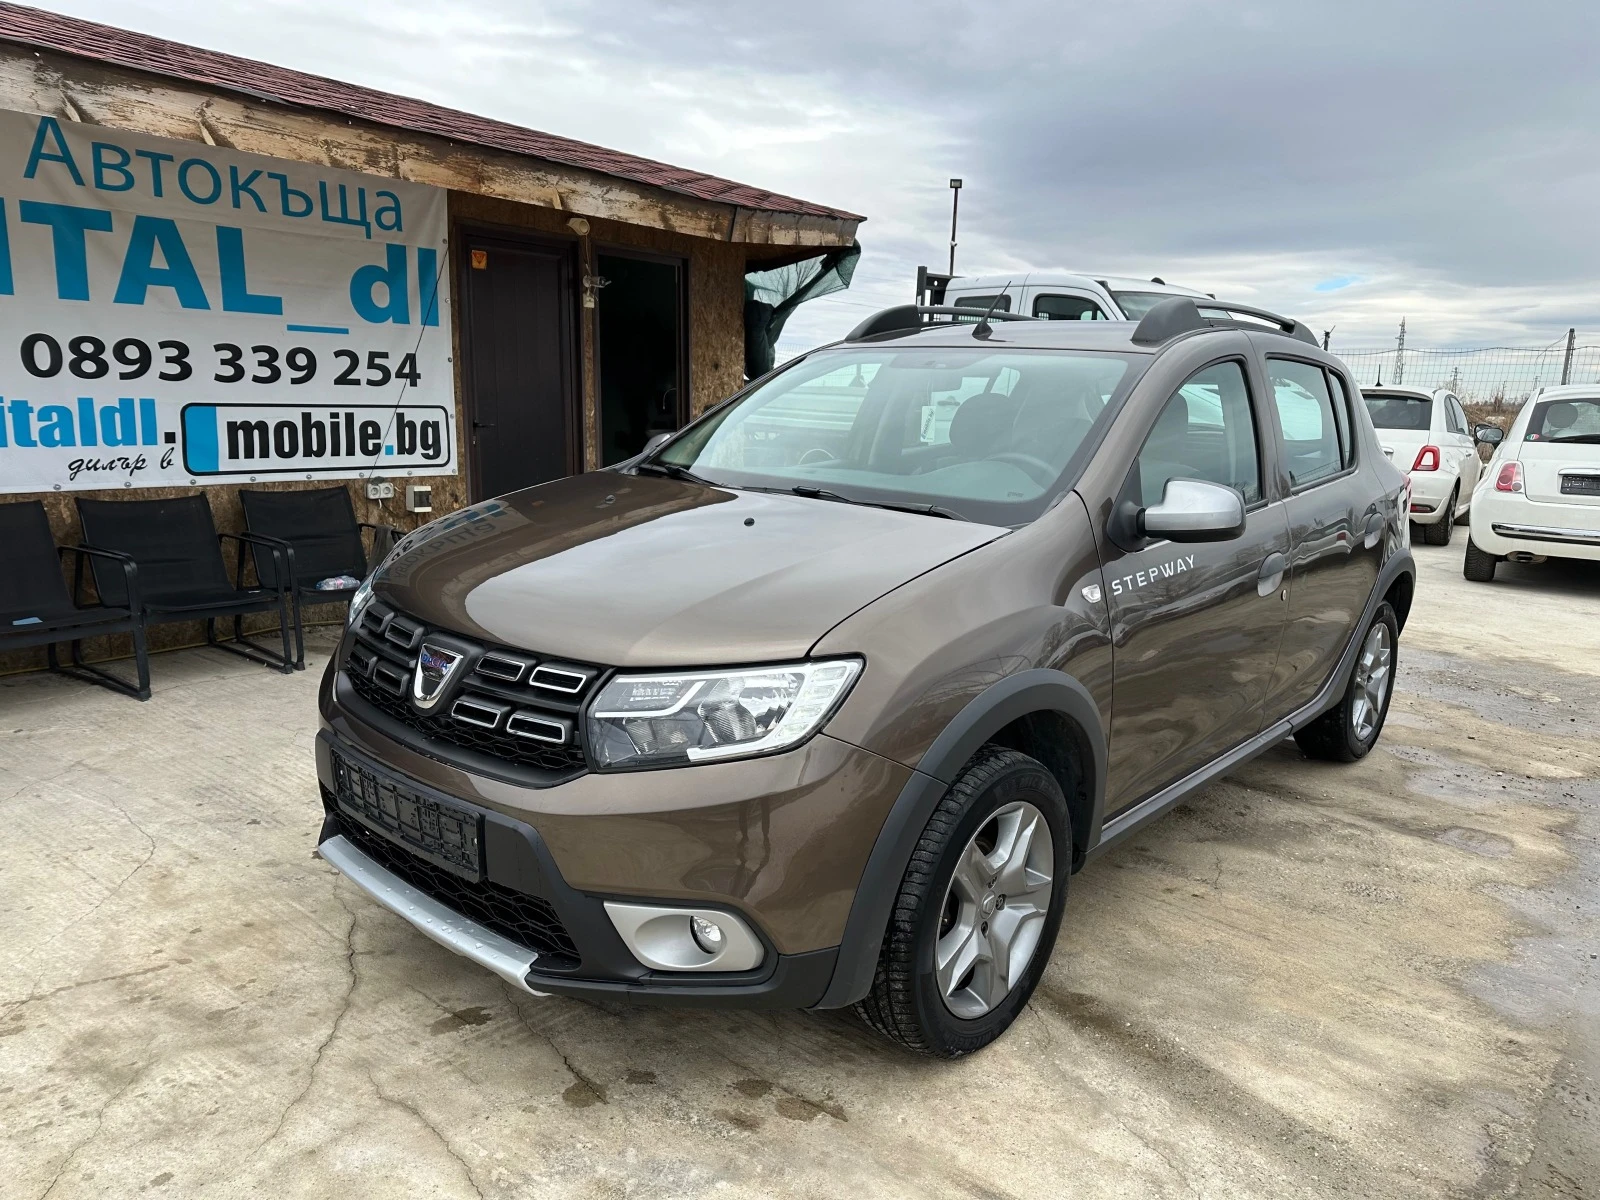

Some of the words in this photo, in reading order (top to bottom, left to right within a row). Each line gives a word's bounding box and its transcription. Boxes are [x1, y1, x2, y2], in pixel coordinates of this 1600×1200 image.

[24, 116, 404, 239] Автокъща
[20, 333, 194, 382] 0893
[213, 343, 318, 384] 339
[333, 350, 422, 387] 254
[226, 411, 442, 460] mobile.bg
[67, 454, 148, 481] дилър
[159, 446, 175, 470] в
[1111, 554, 1195, 596] STEPWAY
